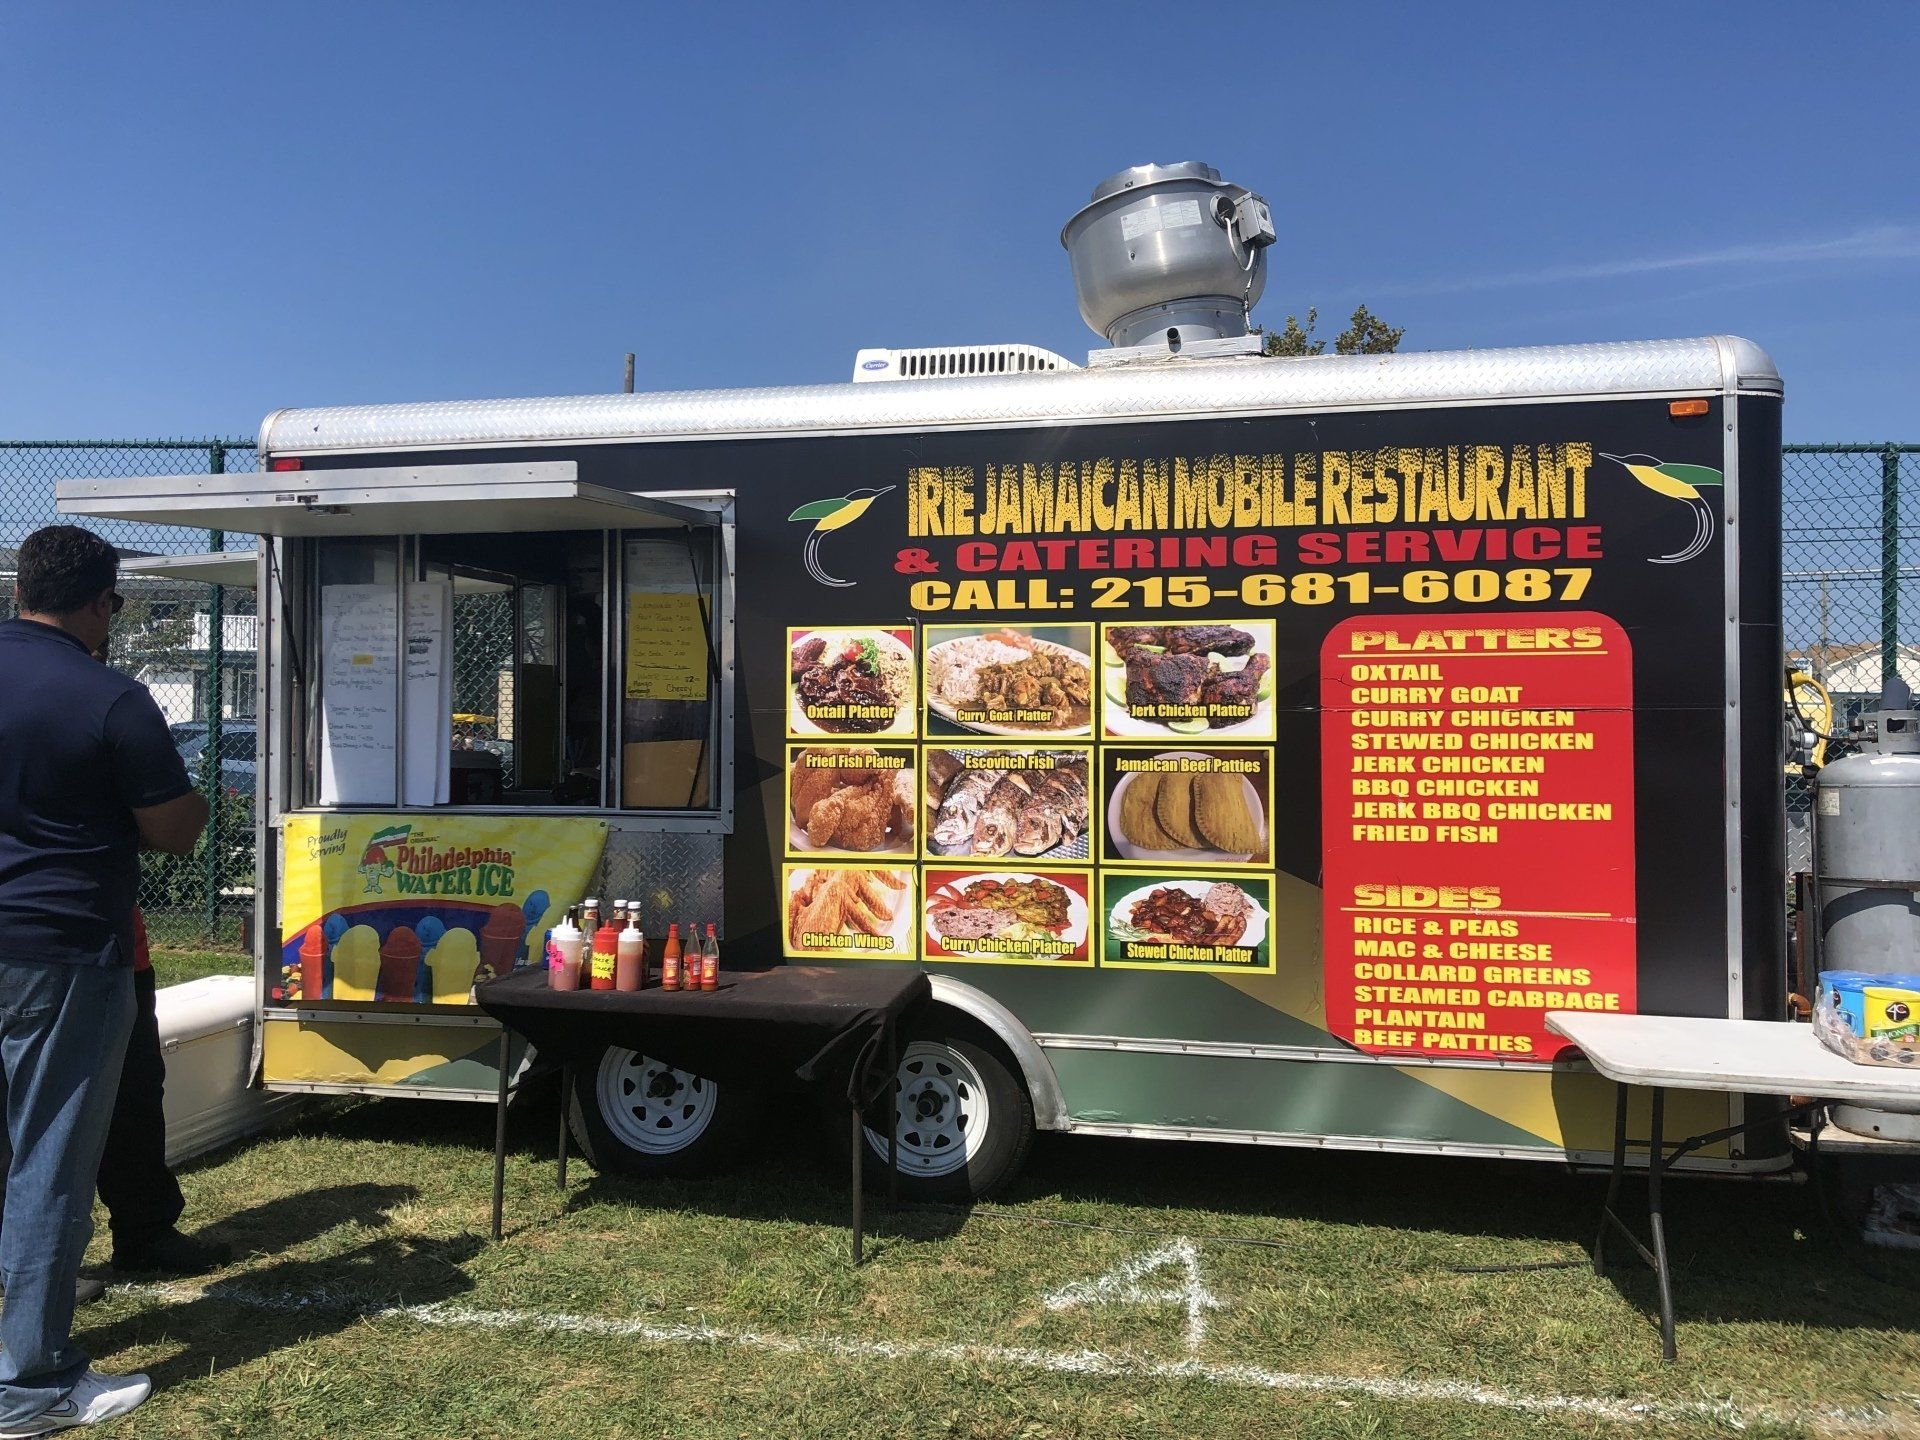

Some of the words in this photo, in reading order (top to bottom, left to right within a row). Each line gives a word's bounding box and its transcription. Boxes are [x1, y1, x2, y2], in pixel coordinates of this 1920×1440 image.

[908, 465, 975, 537] IRIE
[979, 456, 1169, 535] JAMAICAN
[1174, 453, 1317, 530] MOBILE
[1322, 441, 1593, 525] RESTAURANT
[894, 547, 940, 574] &
[956, 534, 1278, 573] CATERING
[1298, 526, 1603, 565] SERVICE
[910, 578, 1074, 612] CALL:
[1091, 567, 1592, 608] 215-681-6087
[1351, 626, 1603, 651] PLATTERS
[1351, 664, 1443, 682] OXTAIL
[1351, 687, 1444, 704] CURRY
[1450, 686, 1523, 703] GOAT
[807, 704, 846, 719] Oxtail
[849, 704, 895, 719] Platter
[957, 709, 986, 723] Curry
[989, 709, 1013, 722] Goat
[1017, 709, 1052, 722] Platter
[1131, 704, 1156, 717] Jerk
[1158, 704, 1207, 717] Chicken
[1209, 704, 1251, 717] Platter
[1351, 710, 1444, 727] CURRY
[1450, 710, 1574, 727] CHICKEN
[1351, 733, 1463, 750] STEWED
[1470, 732, 1594, 750] CHICKEN
[806, 754, 836, 768] Fried
[838, 755, 863, 768] Fish
[865, 755, 906, 769] Platter
[965, 755, 1026, 770] Escovitch
[1028, 755, 1055, 769] Fish
[1116, 757, 1178, 772] Jamaican
[1180, 758, 1212, 772] Beef
[1213, 758, 1261, 773] Patties
[1351, 756, 1416, 773] JERK
[1422, 756, 1545, 773] CHICKEN
[1352, 779, 1410, 797] BBQ
[1416, 779, 1539, 796] CHICKEN
[1352, 802, 1417, 819] JERK
[1423, 802, 1481, 821] BBQ
[1487, 803, 1612, 821] CHICKEN
[307, 828, 348, 848] Proudly
[1352, 824, 1429, 842] FRIED
[1436, 825, 1498, 843] FISH
[309, 842, 346, 861] Serving
[396, 845, 513, 875] Philadelphia
[395, 866, 472, 895] WATER
[475, 863, 515, 897] ICE
[1354, 884, 1502, 909] SIDES
[1354, 917, 1417, 935] RICE
[1423, 920, 1444, 936] &
[1450, 919, 1519, 937] PEAS
[802, 932, 853, 948] Chicken
[854, 934, 894, 949] Wings
[941, 936, 976, 953] Curry
[978, 938, 1030, 953] Chicken
[1032, 939, 1076, 955] Platter
[1127, 942, 1167, 959] Stewed
[1169, 944, 1214, 961] Chicken
[1215, 947, 1252, 963] Platter
[1354, 940, 1416, 958] MAC
[1422, 943, 1443, 959] &
[1449, 942, 1553, 962] CHEESE
[1354, 963, 1477, 983] COLLARD
[1483, 966, 1591, 986] GREENS
[1354, 986, 1481, 1006] STEAMED
[1487, 989, 1620, 1011] CABBAGE
[1355, 1008, 1485, 1030] PLANTAIN
[1886, 1003, 1907, 1020] 4C
[1354, 1029, 1417, 1047] BEEF
[1422, 1032, 1533, 1053] PATTIES
